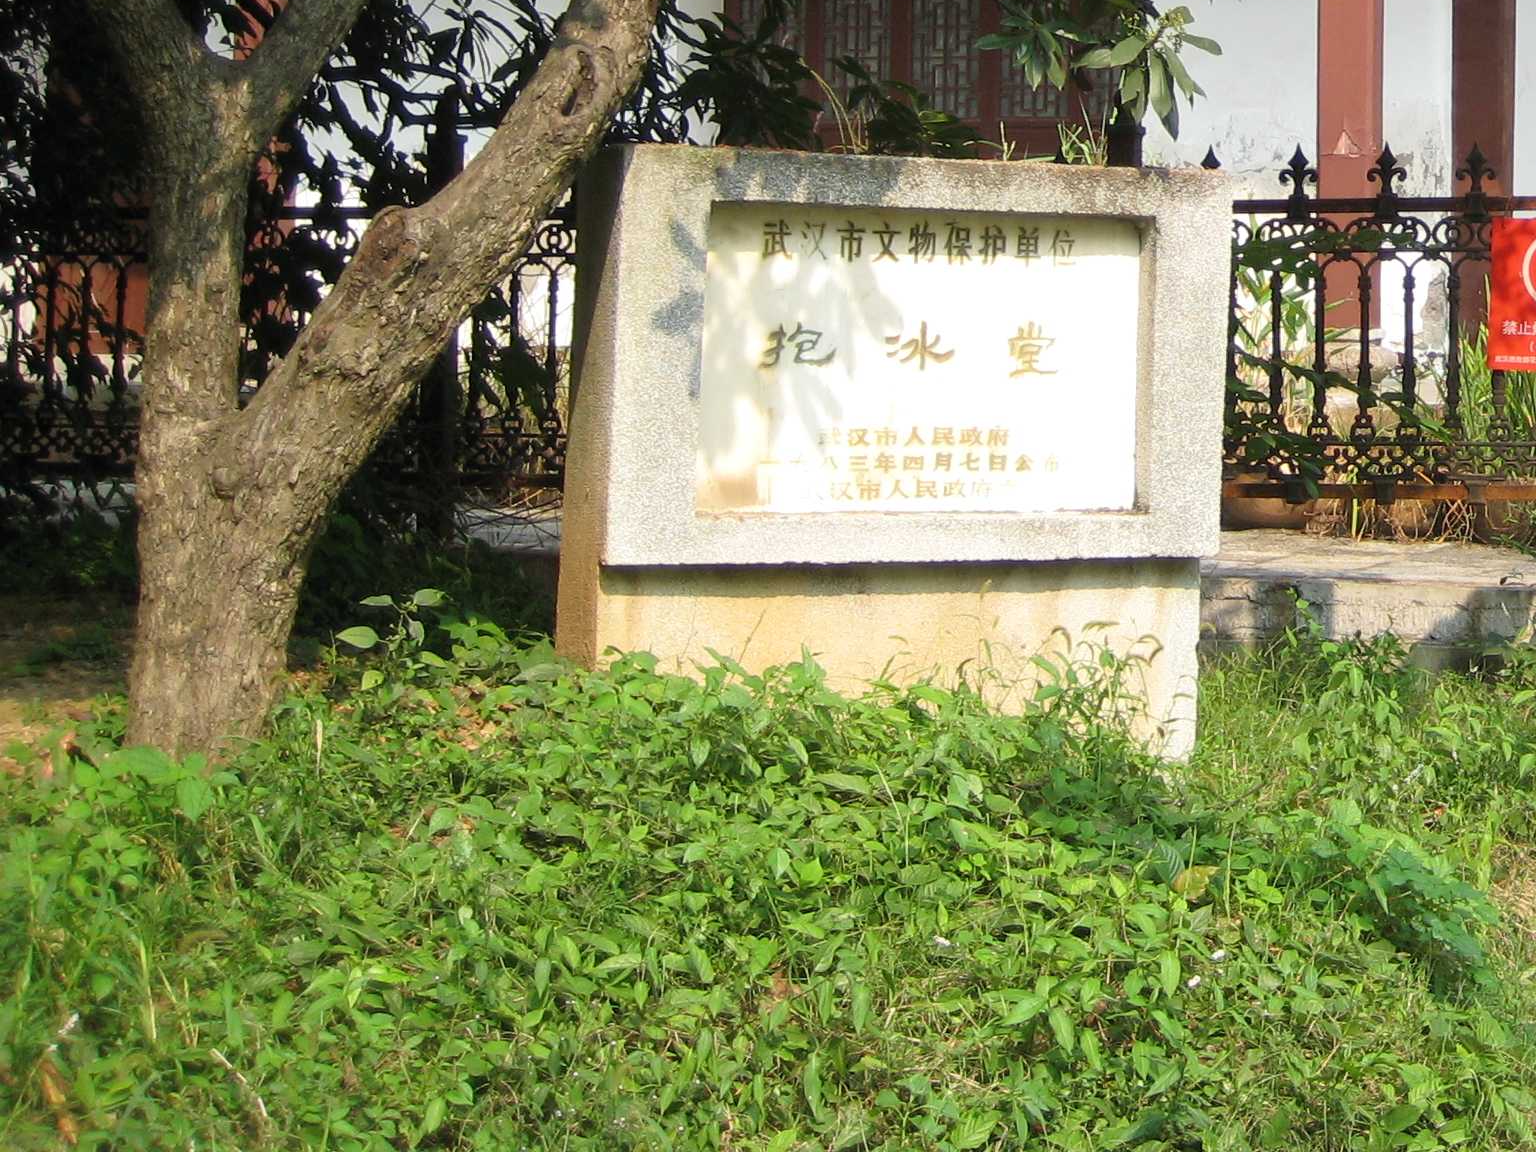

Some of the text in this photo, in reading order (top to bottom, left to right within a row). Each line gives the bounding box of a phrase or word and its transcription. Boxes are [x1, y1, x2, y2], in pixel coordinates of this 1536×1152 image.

[763, 218, 1077, 267] 武汉市文物保护单位
[758, 320, 1058, 378] 抱冰堂
